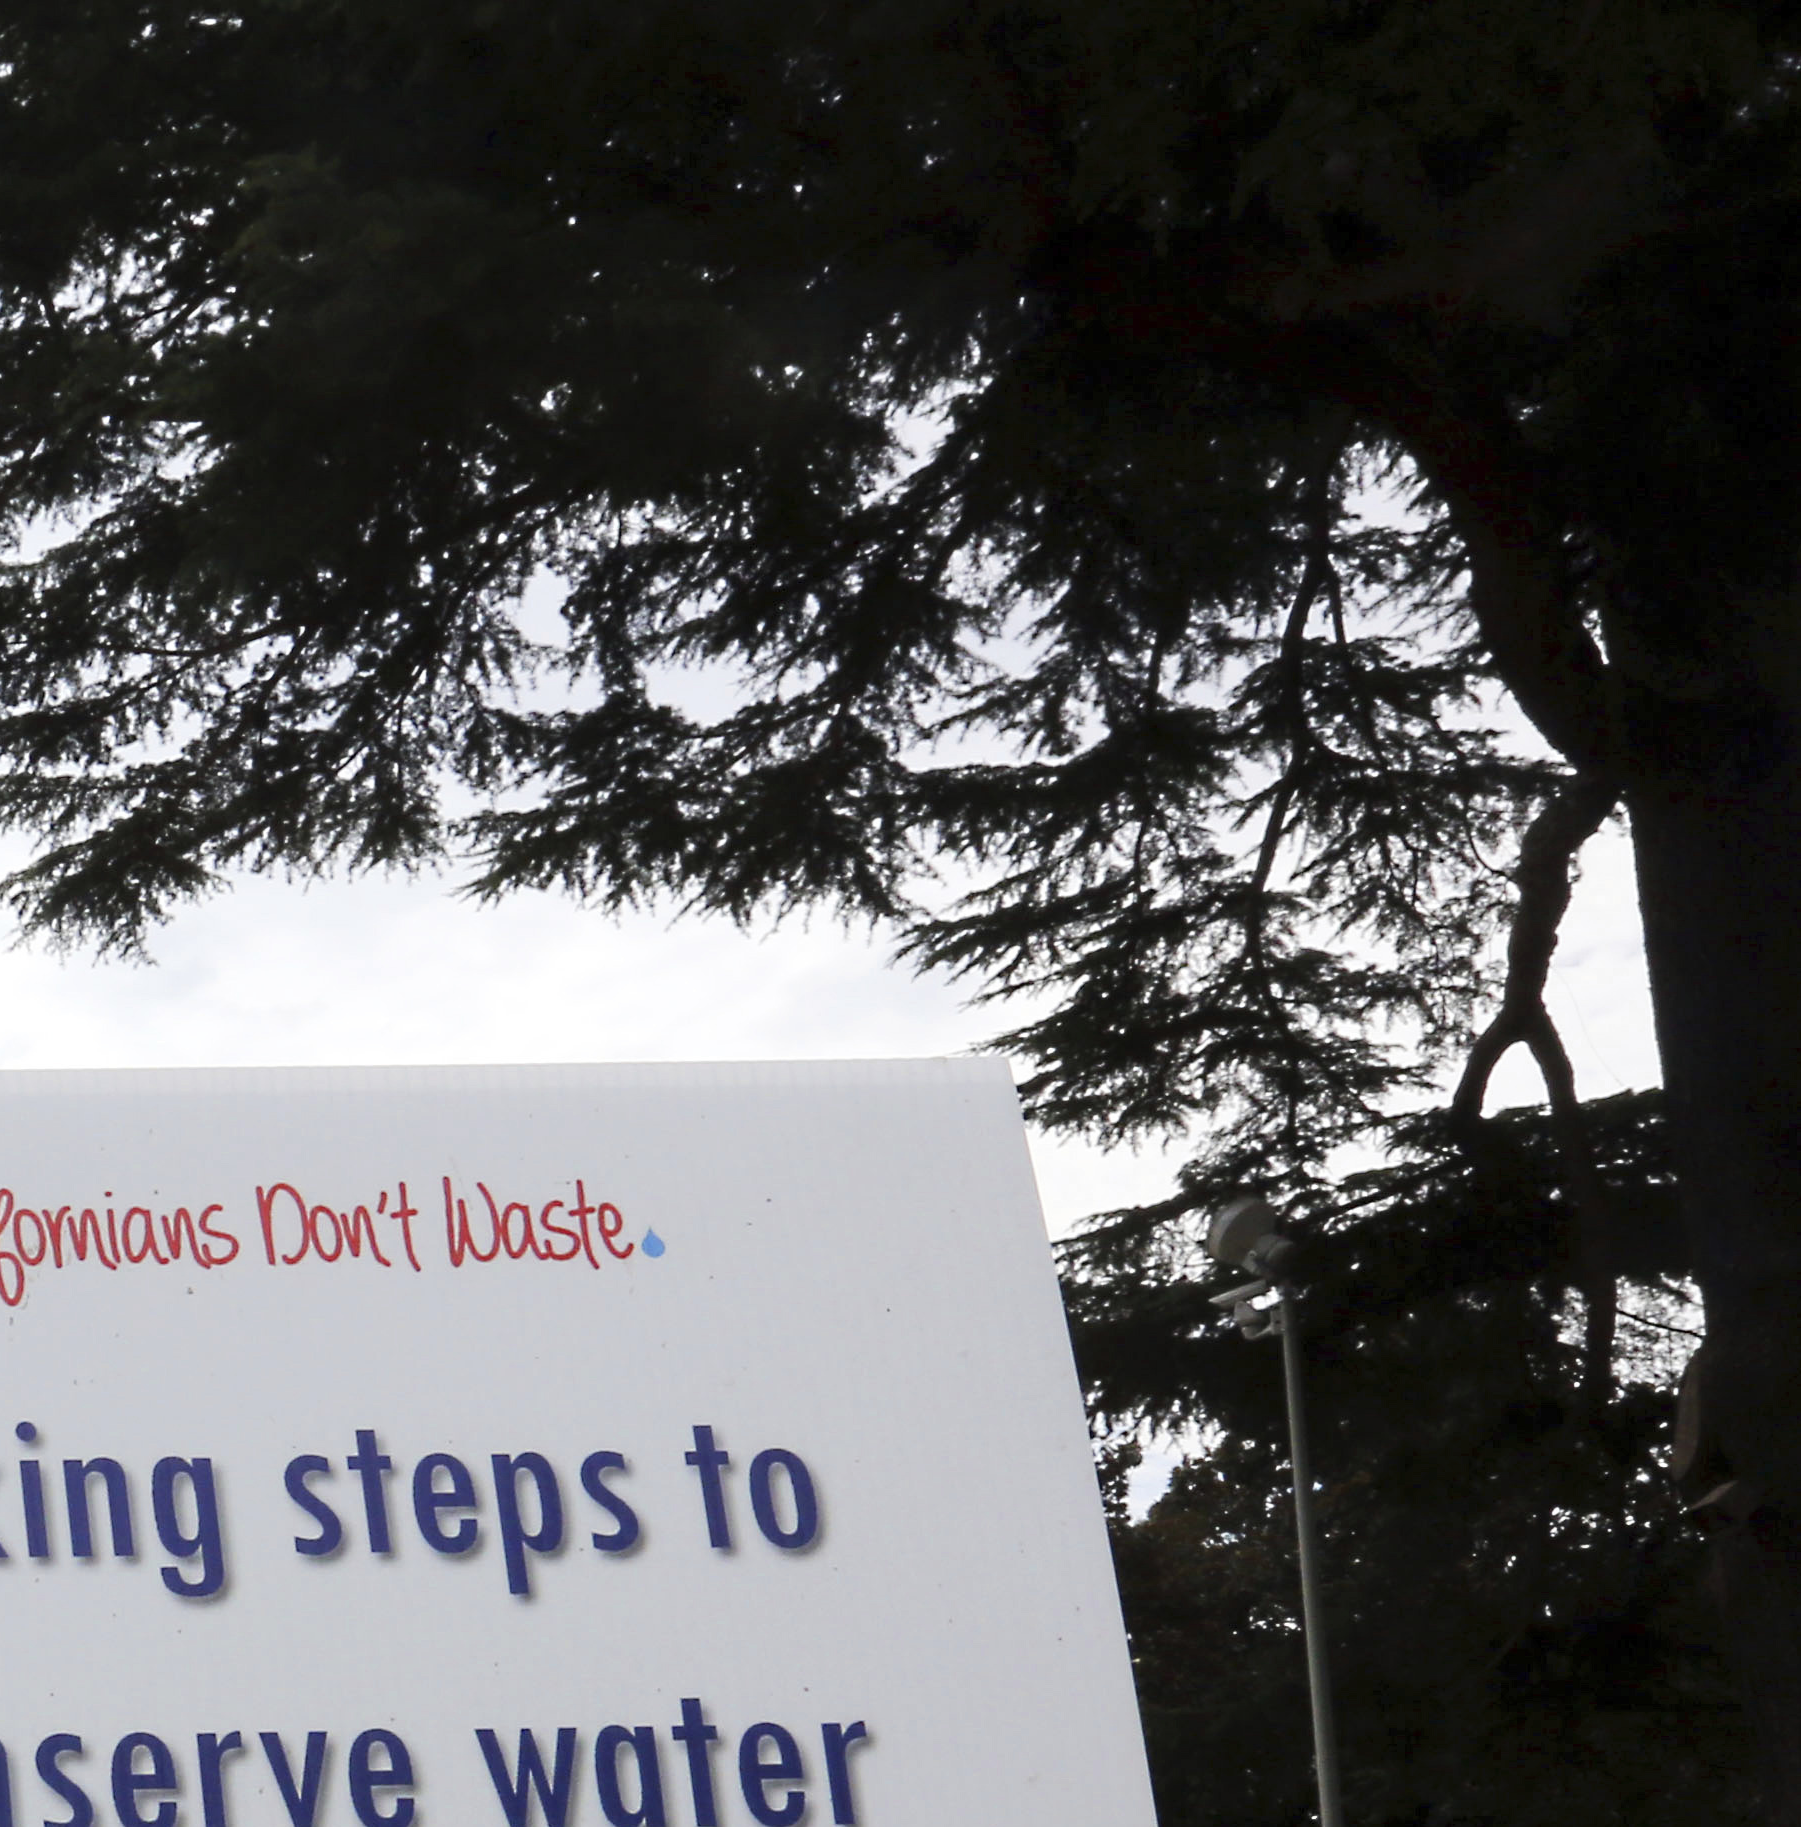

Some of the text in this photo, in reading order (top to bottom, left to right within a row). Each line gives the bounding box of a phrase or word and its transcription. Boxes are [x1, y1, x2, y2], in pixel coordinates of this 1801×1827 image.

[255, 1181, 422, 1273] Don't
[282, 1430, 639, 1597] steps
[683, 1424, 820, 1552] to
